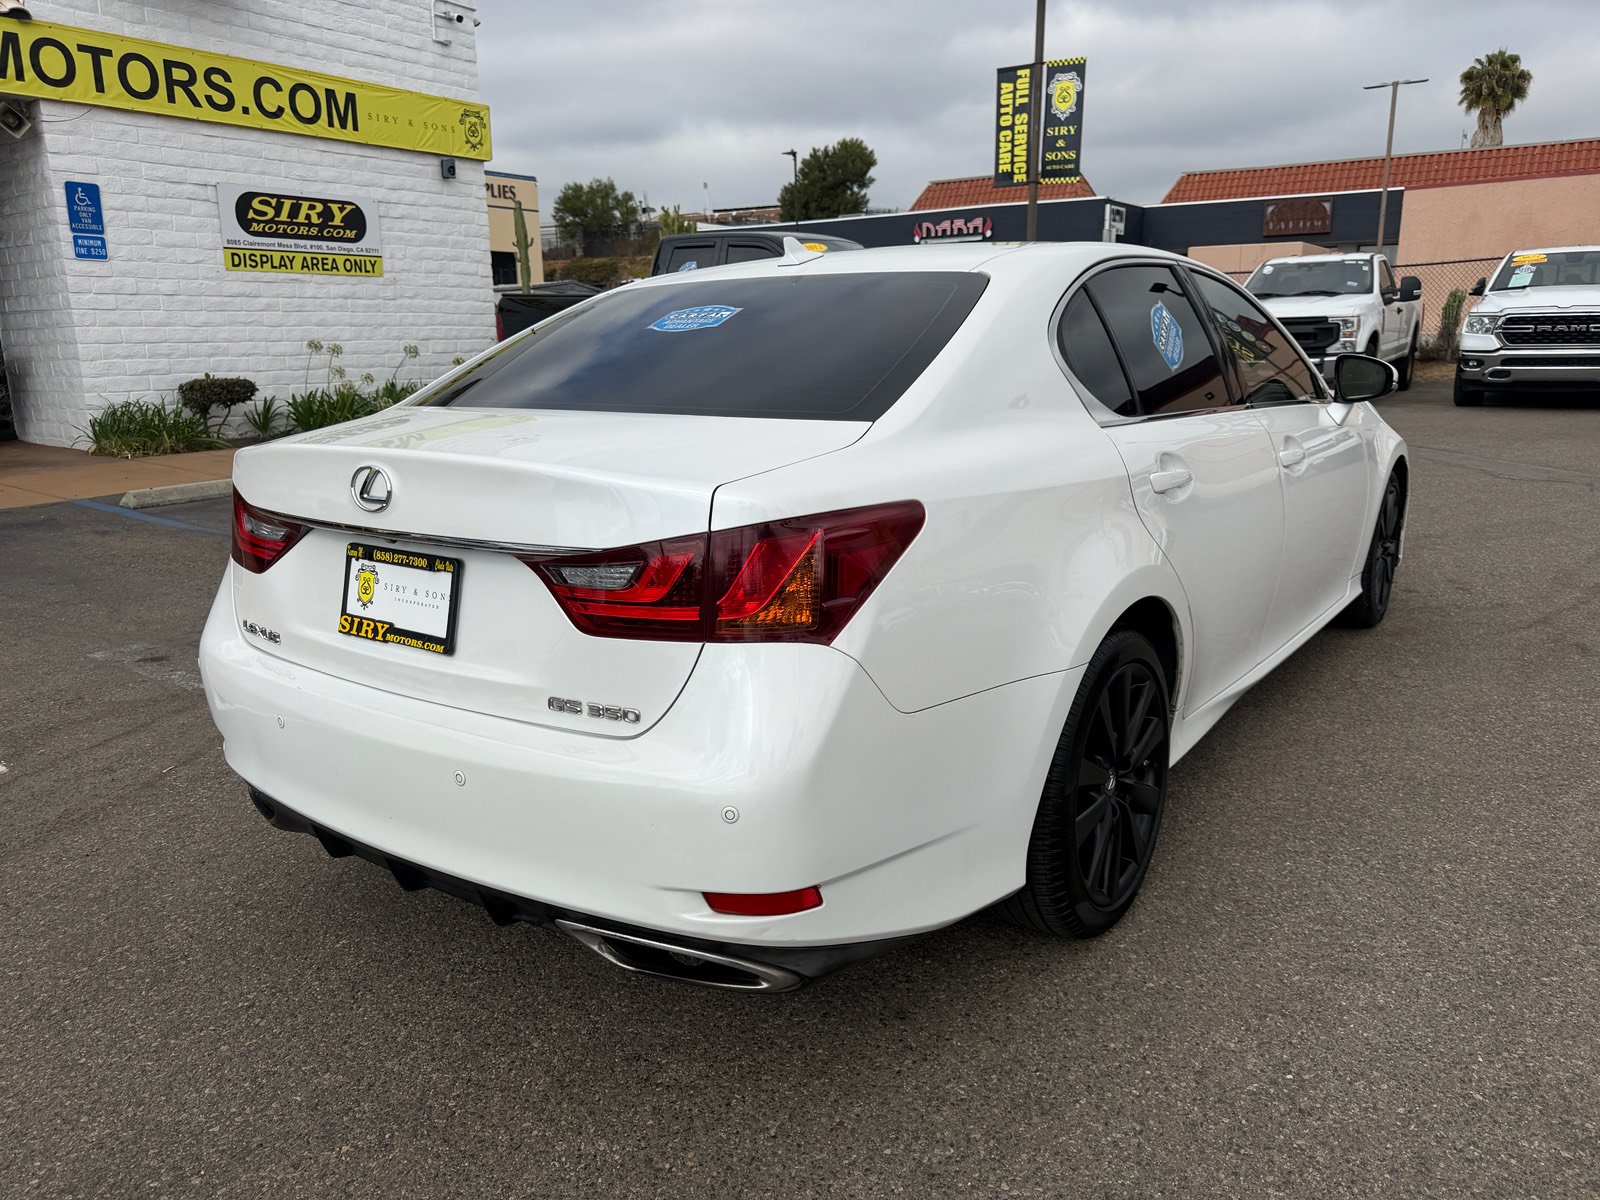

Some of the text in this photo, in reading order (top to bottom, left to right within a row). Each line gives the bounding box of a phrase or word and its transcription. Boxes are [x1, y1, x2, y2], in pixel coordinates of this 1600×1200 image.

[0, 31, 359, 131] MOTORS.COM
[367, 112, 456, 134] SIRY & SONS
[998, 82, 1014, 174] AUTO CARE
[1013, 68, 1031, 183] FULL SERVICE
[1046, 125, 1077, 137] SIRY
[1055, 139, 1066, 148] &
[1045, 150, 1077, 161] SONS
[247, 196, 356, 226] SIRY
[249, 222, 357, 239] MOTORS.COM
[75, 246, 107, 256] FINE $250
[226, 238, 242, 246] 8085
[242, 239, 277, 248] Clairemont
[277, 241, 293, 249] Mesa
[293, 242, 309, 251] Blvd,
[325, 244, 337, 252] San
[231, 252, 378, 274] DISPLAY AREA ONLY
[1536, 324, 1588, 332] RAM
[373, 549, 393, 563] (858)
[393, 554, 428, 568] 277-7300
[384, 583, 450, 601] SIRY & SON
[394, 597, 440, 610] INCORPORATED
[243, 619, 281, 645] LEXUS
[338, 615, 445, 654] SIRY MOTORS.COM
[547, 696, 641, 724] GS 350
